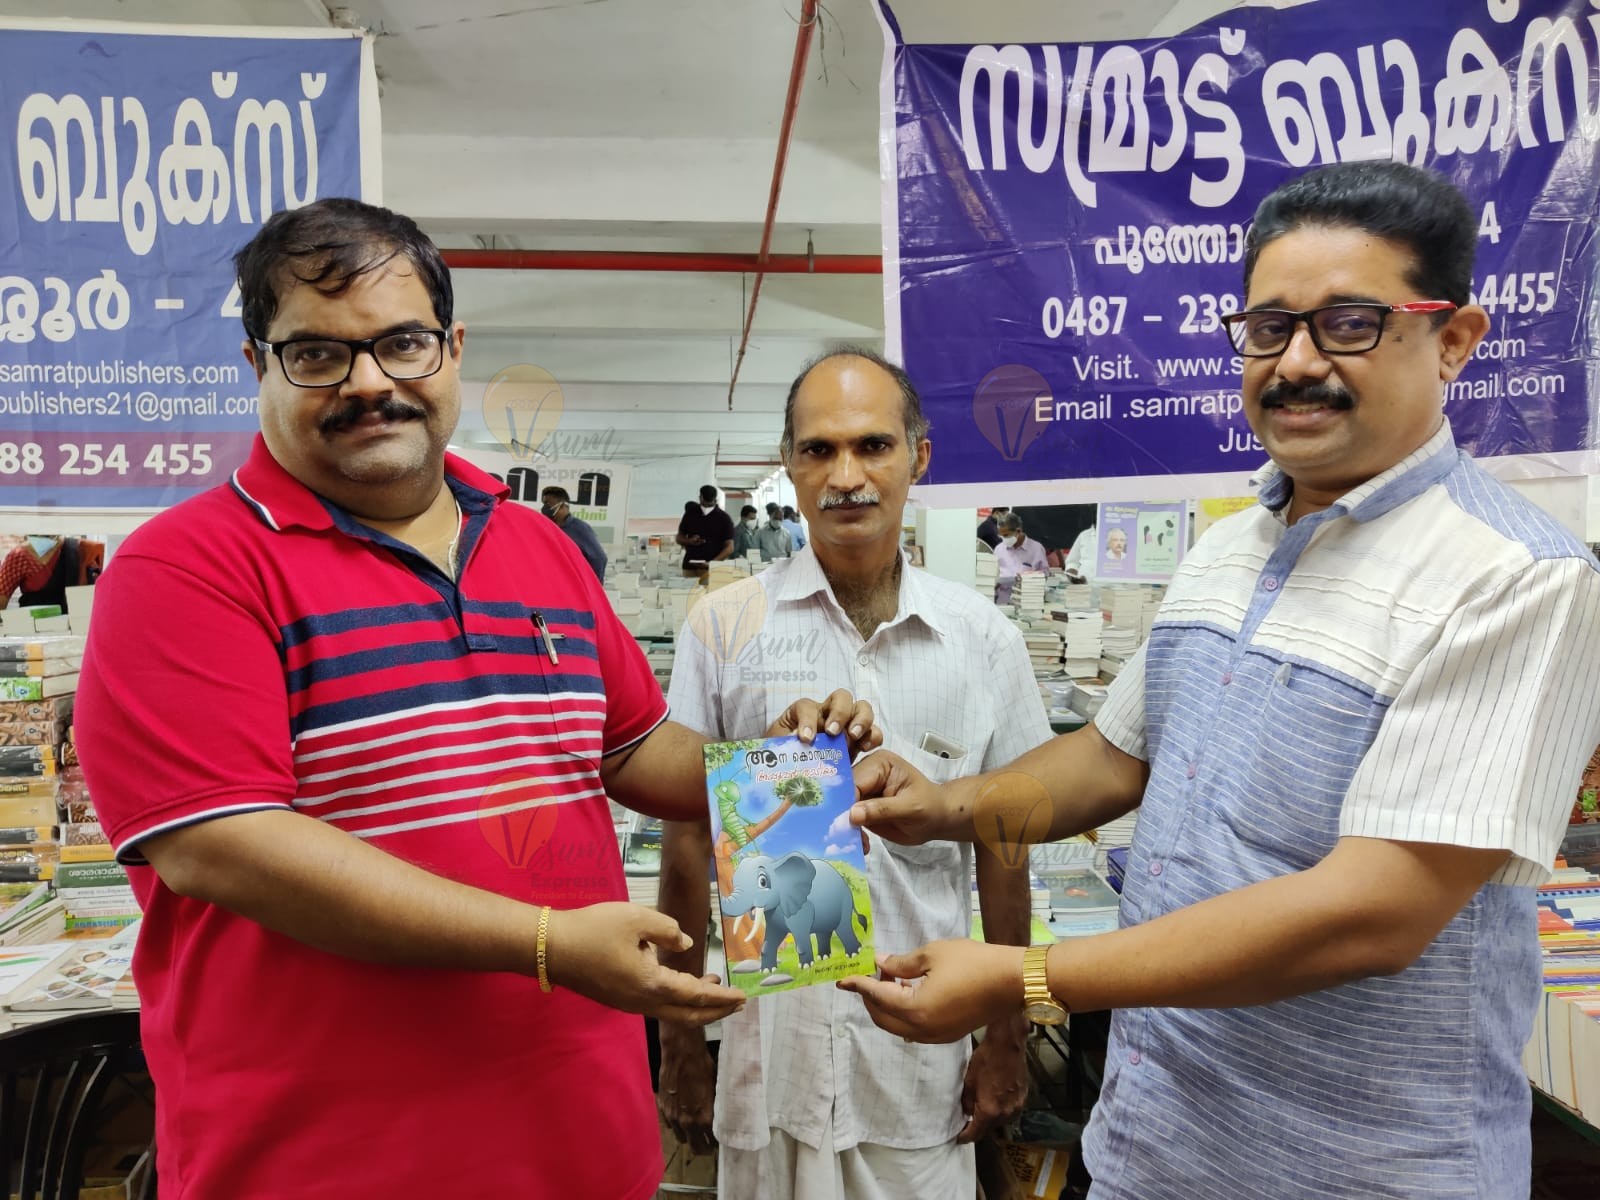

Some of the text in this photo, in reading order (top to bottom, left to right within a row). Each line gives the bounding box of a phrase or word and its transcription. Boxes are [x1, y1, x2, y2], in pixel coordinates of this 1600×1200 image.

[959, 0, 1600, 208] സമ്രാട്ട് ബുക്സ
[17, 71, 327, 256] ബുക്സ്
[1095, 223, 1249, 274] പൂത്തോ
[1042, 296, 1128, 338] 0487
[1178, 293, 1244, 334] 238
[0, 360, 239, 389] samratpublishers.com
[1073, 355, 1139, 382] Visit.
[1035, 394, 1112, 422] Email
[0, 442, 213, 475] 88 254 455
